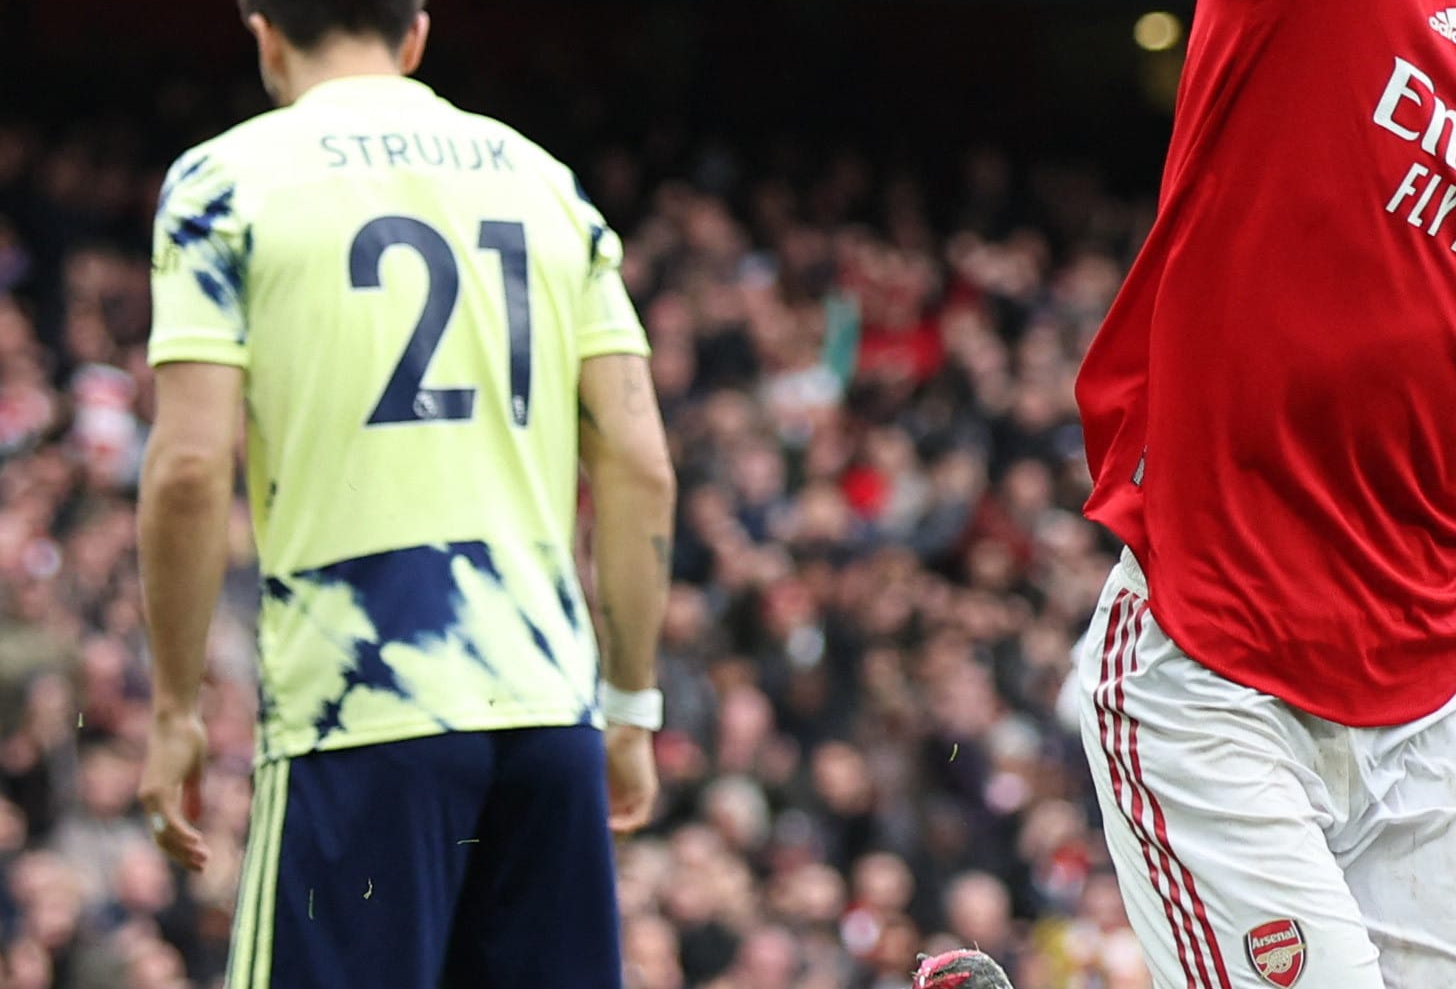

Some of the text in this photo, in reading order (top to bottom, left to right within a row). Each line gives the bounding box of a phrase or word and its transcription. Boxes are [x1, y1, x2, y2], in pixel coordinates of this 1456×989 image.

[319, 133, 515, 171] STRUIJK
[349, 215, 532, 430] 21
[1252, 926, 1297, 950] Arsenal
